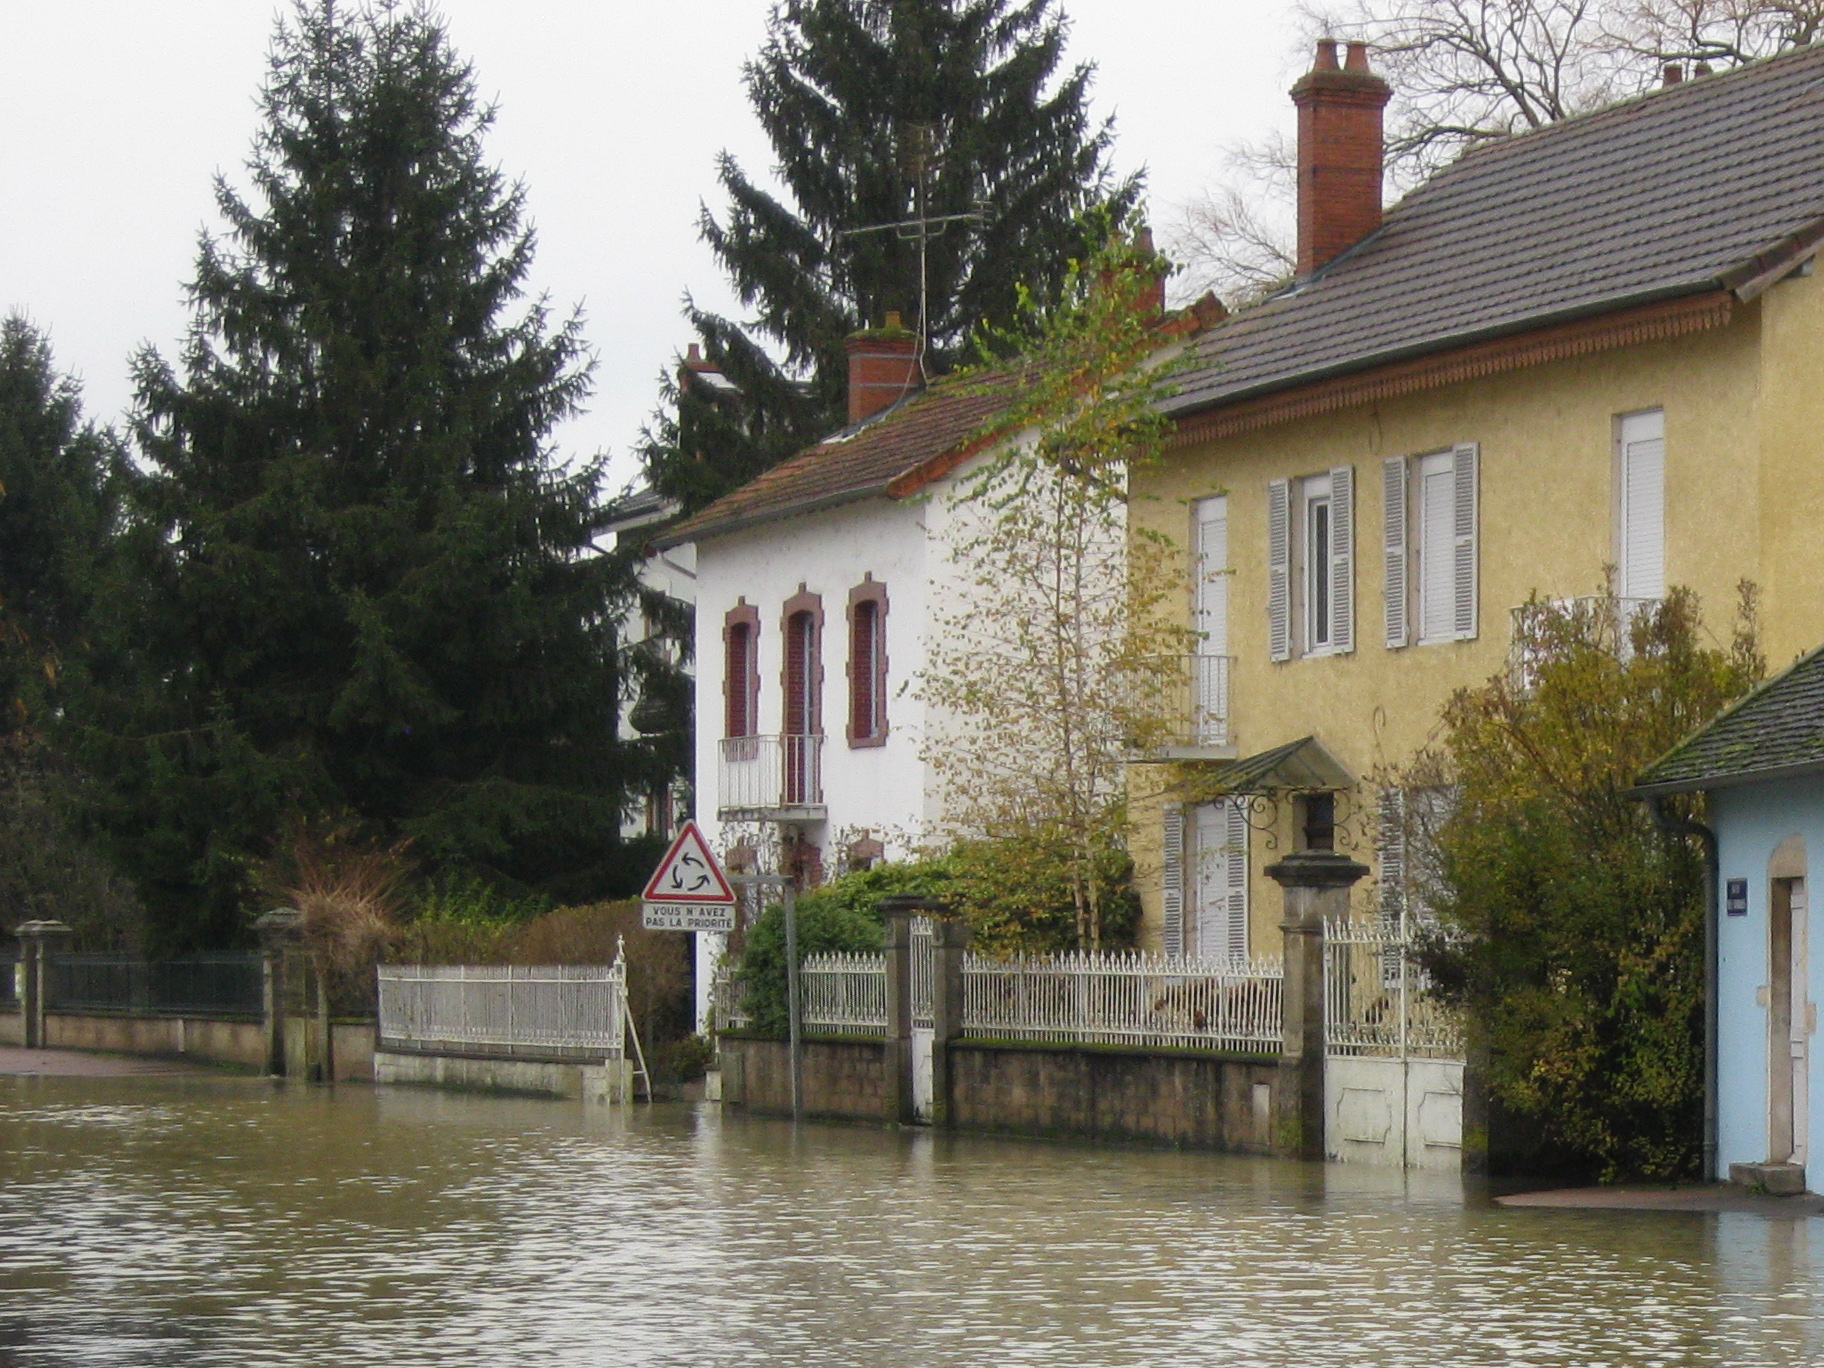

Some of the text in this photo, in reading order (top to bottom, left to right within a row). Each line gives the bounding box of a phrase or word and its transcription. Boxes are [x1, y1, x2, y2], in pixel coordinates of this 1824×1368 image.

[653, 906, 681, 916] VOUS
[646, 917, 732, 928] PAS LA PRIORITÉ
